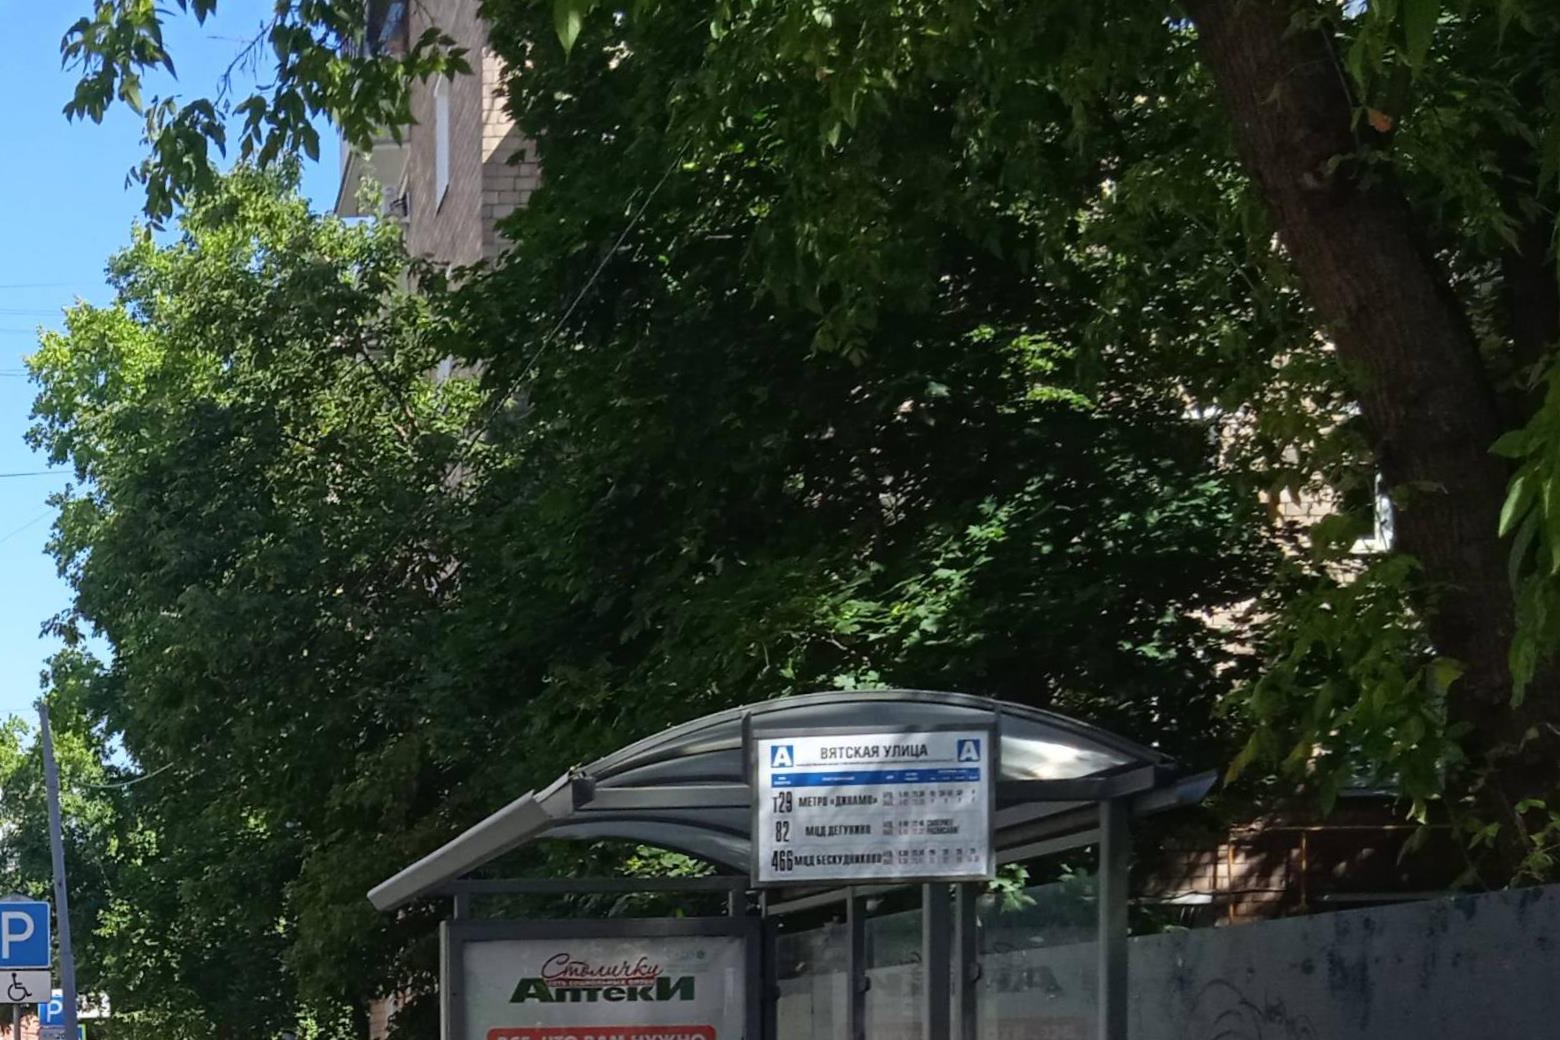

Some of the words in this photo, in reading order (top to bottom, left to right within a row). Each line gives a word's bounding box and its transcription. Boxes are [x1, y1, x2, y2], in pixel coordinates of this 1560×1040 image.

[820, 745, 880, 760] ВЯТСКАЯ
[884, 744, 928, 759] УЛИЦА
[775, 821, 790, 842] 82
[771, 850, 793, 871] 466
[2, 911, 35, 959] P
[541, 952, 664, 979] Столички
